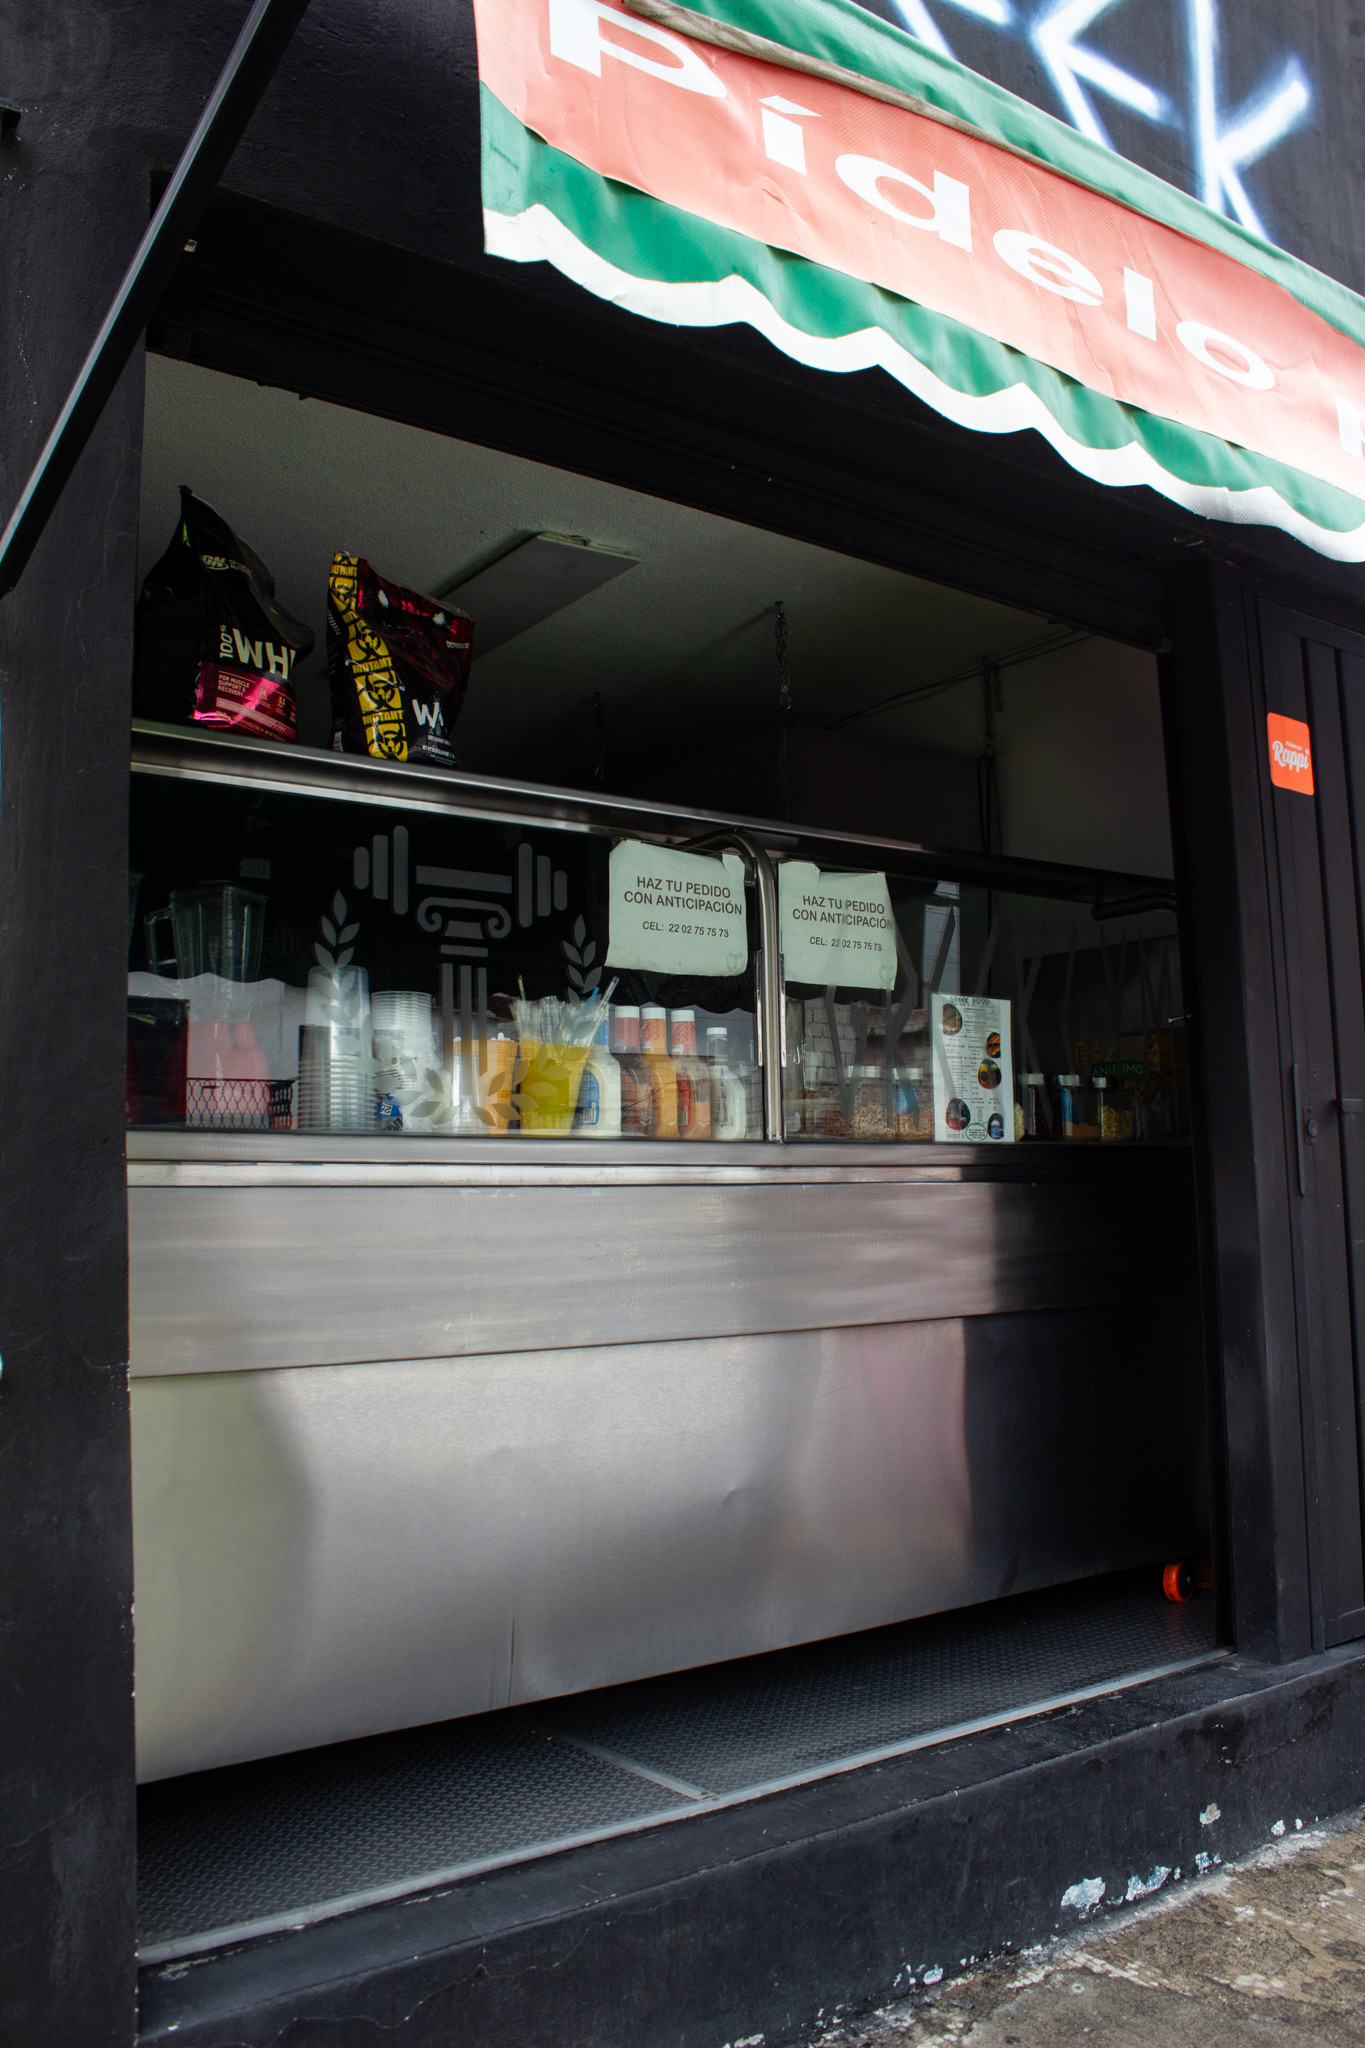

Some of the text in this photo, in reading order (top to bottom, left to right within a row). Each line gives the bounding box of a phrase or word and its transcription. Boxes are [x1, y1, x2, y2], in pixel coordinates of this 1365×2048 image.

[549, 0, 1276, 390] Pídelo
[352, 656, 392, 674] MUTANT
[218, 674, 250, 688] FOR MUSCLE
[218, 680, 242, 691] SUPPORT
[217, 685, 244, 697] RECOVERY
[361, 709, 405, 726] MUTANT
[1272, 740, 1310, 773] Rappi
[637, 876, 731, 898] HAZ TU PEDIDO
[624, 890, 743, 915] CON ANTICIPACIÓN
[802, 895, 885, 914] HAZ TU PEDIDO
[792, 908, 817, 922] CON
[642, 920, 730, 938] CEL: 22 02 75 75 73
[809, 936, 828, 946] CEL:
[842, 939, 851, 949] 02
[853, 940, 862, 949] 75
[864, 941, 873, 951] 75
[874, 943, 882, 951] 73
